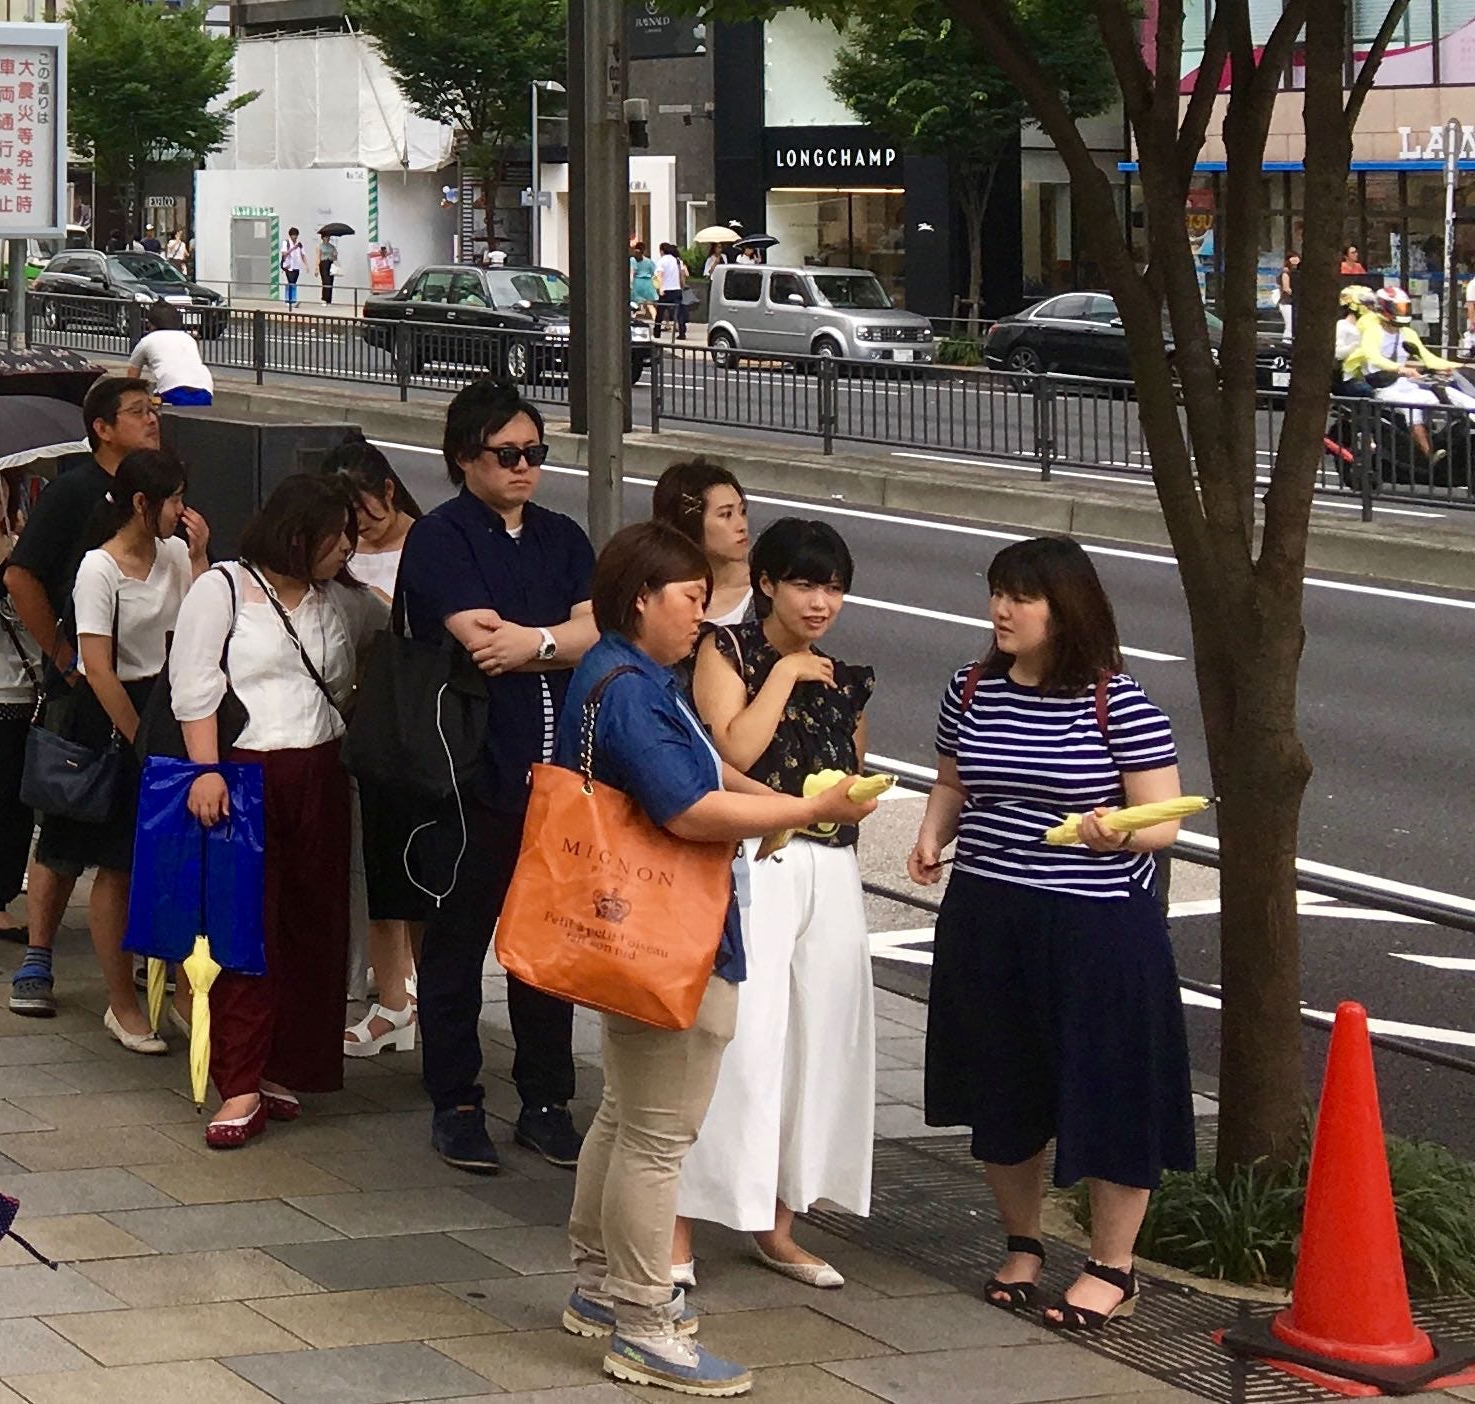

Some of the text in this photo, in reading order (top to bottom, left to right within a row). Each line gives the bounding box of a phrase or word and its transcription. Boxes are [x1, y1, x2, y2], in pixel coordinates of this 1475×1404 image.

[37, 53, 50, 125] この通りは
[16, 59, 35, 214] 大震災等発生時
[776, 148, 896, 167] LONGCHAMP
[561, 837, 674, 888] MIGNON
